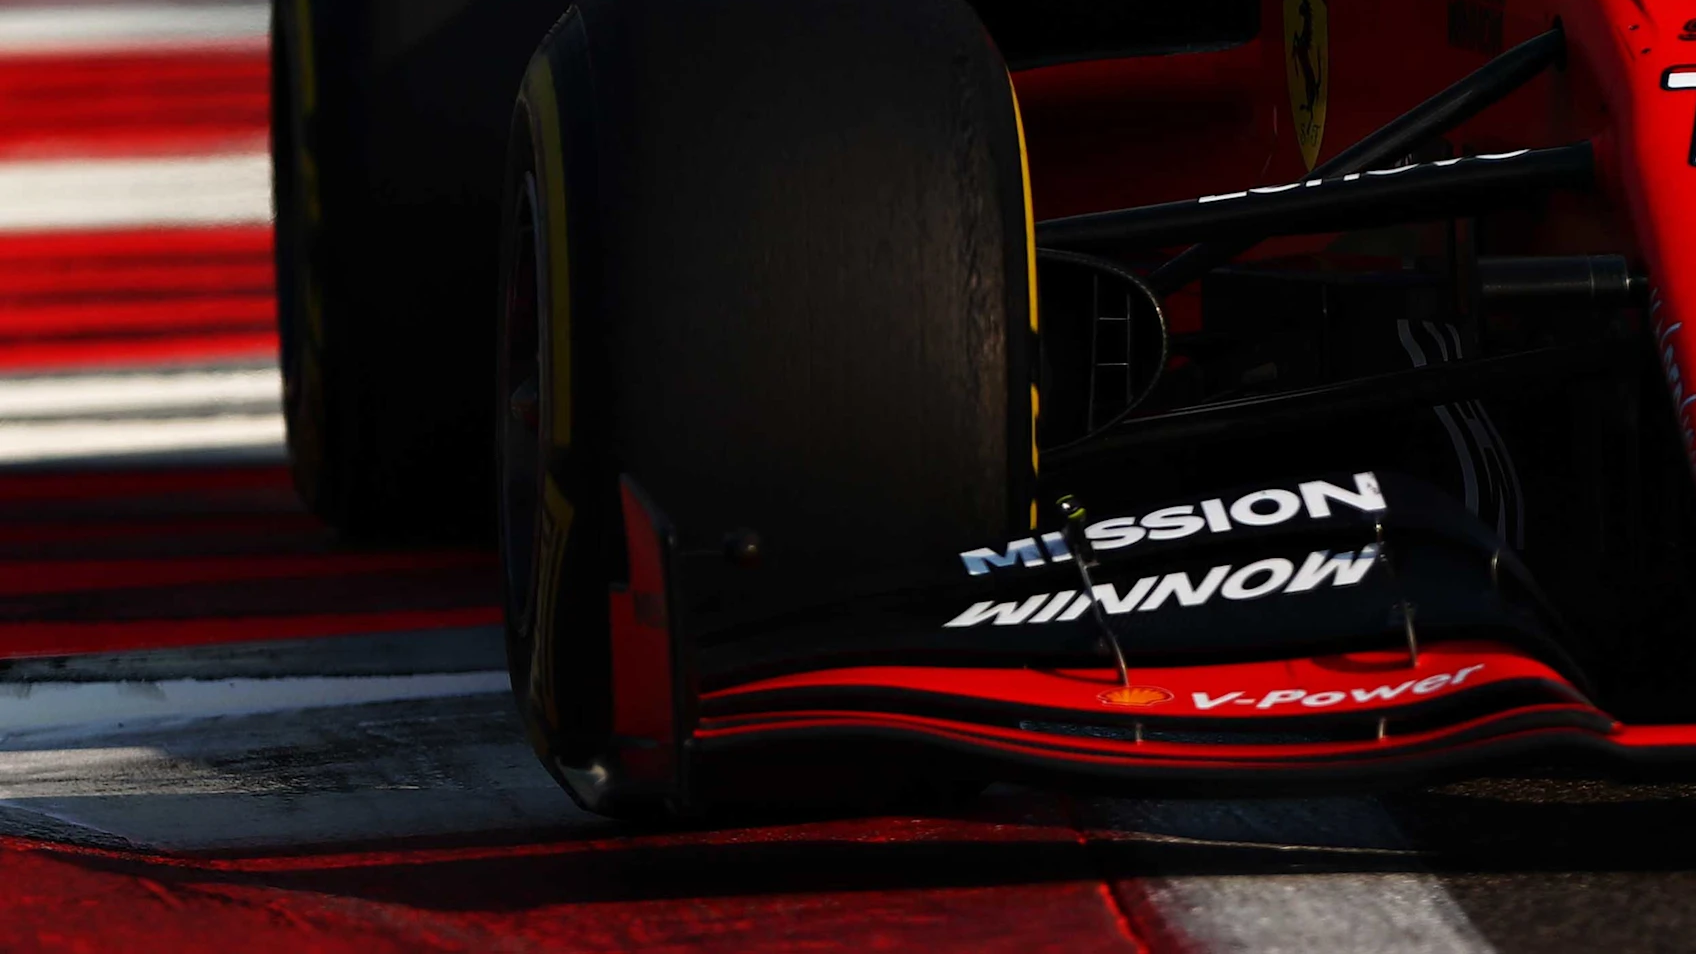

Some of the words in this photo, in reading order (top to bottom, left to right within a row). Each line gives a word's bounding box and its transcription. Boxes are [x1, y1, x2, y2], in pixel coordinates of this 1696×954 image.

[959, 472, 1387, 575] MISSION
[942, 542, 1382, 628] WINNOW
[1191, 663, 1485, 711] V-Power
